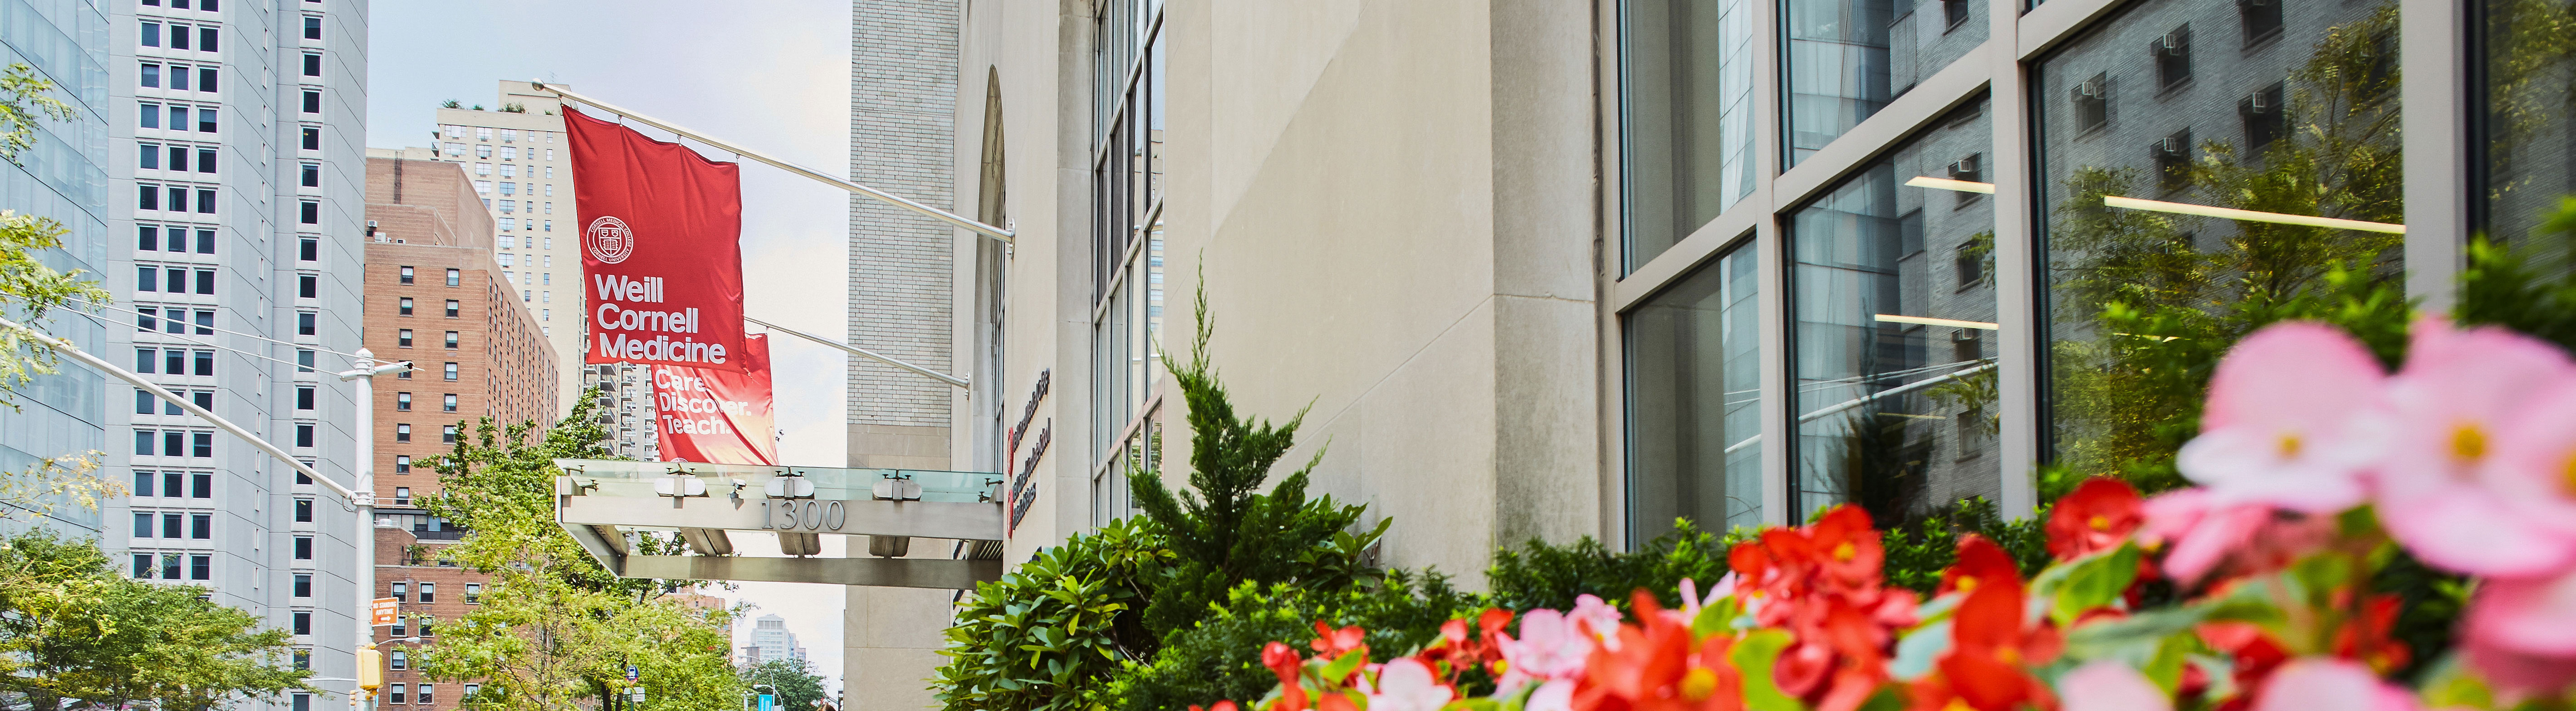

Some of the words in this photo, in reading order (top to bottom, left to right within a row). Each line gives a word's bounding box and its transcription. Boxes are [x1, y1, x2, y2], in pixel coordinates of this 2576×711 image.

[590, 219, 606, 233] CORNELL
[606, 218, 624, 229] MEDICAL
[592, 247, 607, 261] CORNELL
[608, 248, 629, 262] UNIVERSITY
[595, 274, 663, 303] Weill
[597, 303, 698, 333] Cornell
[599, 332, 726, 364] Medicine
[663, 415, 731, 434] Teach.
[761, 499, 845, 530] 1300
